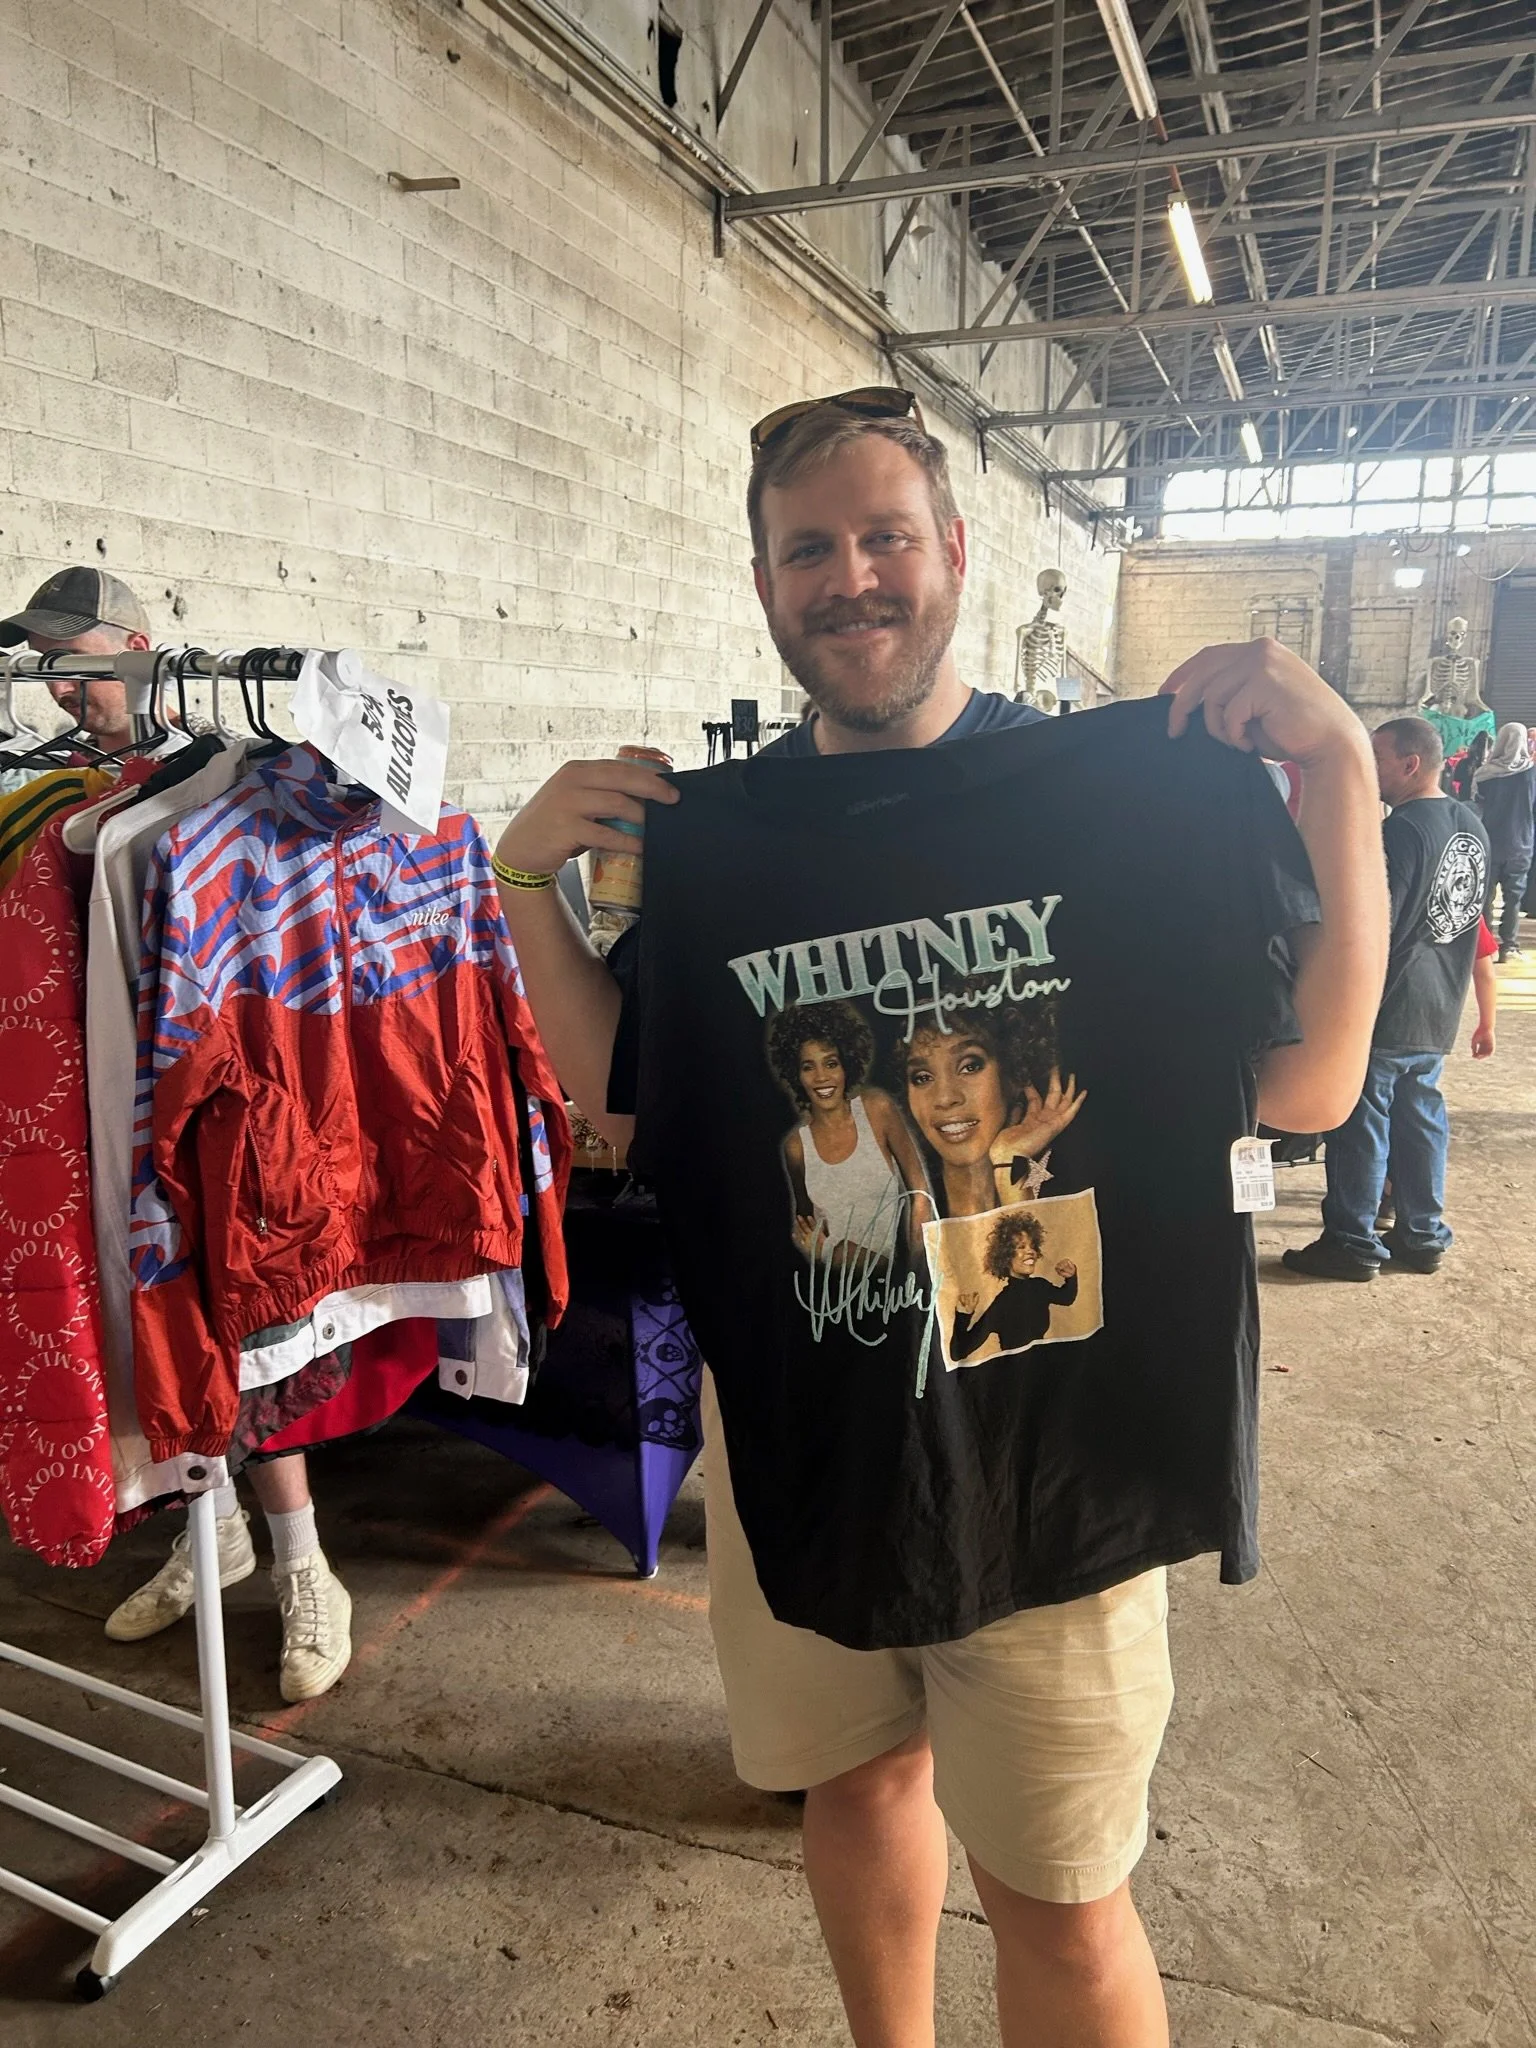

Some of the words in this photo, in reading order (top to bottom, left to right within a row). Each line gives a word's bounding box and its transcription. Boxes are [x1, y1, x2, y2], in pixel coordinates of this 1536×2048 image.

[387, 688, 418, 767] CLOES
[412, 905, 450, 926] nike
[727, 894, 1063, 1018] WHITNEY
[873, 947, 1072, 1043] Houston
